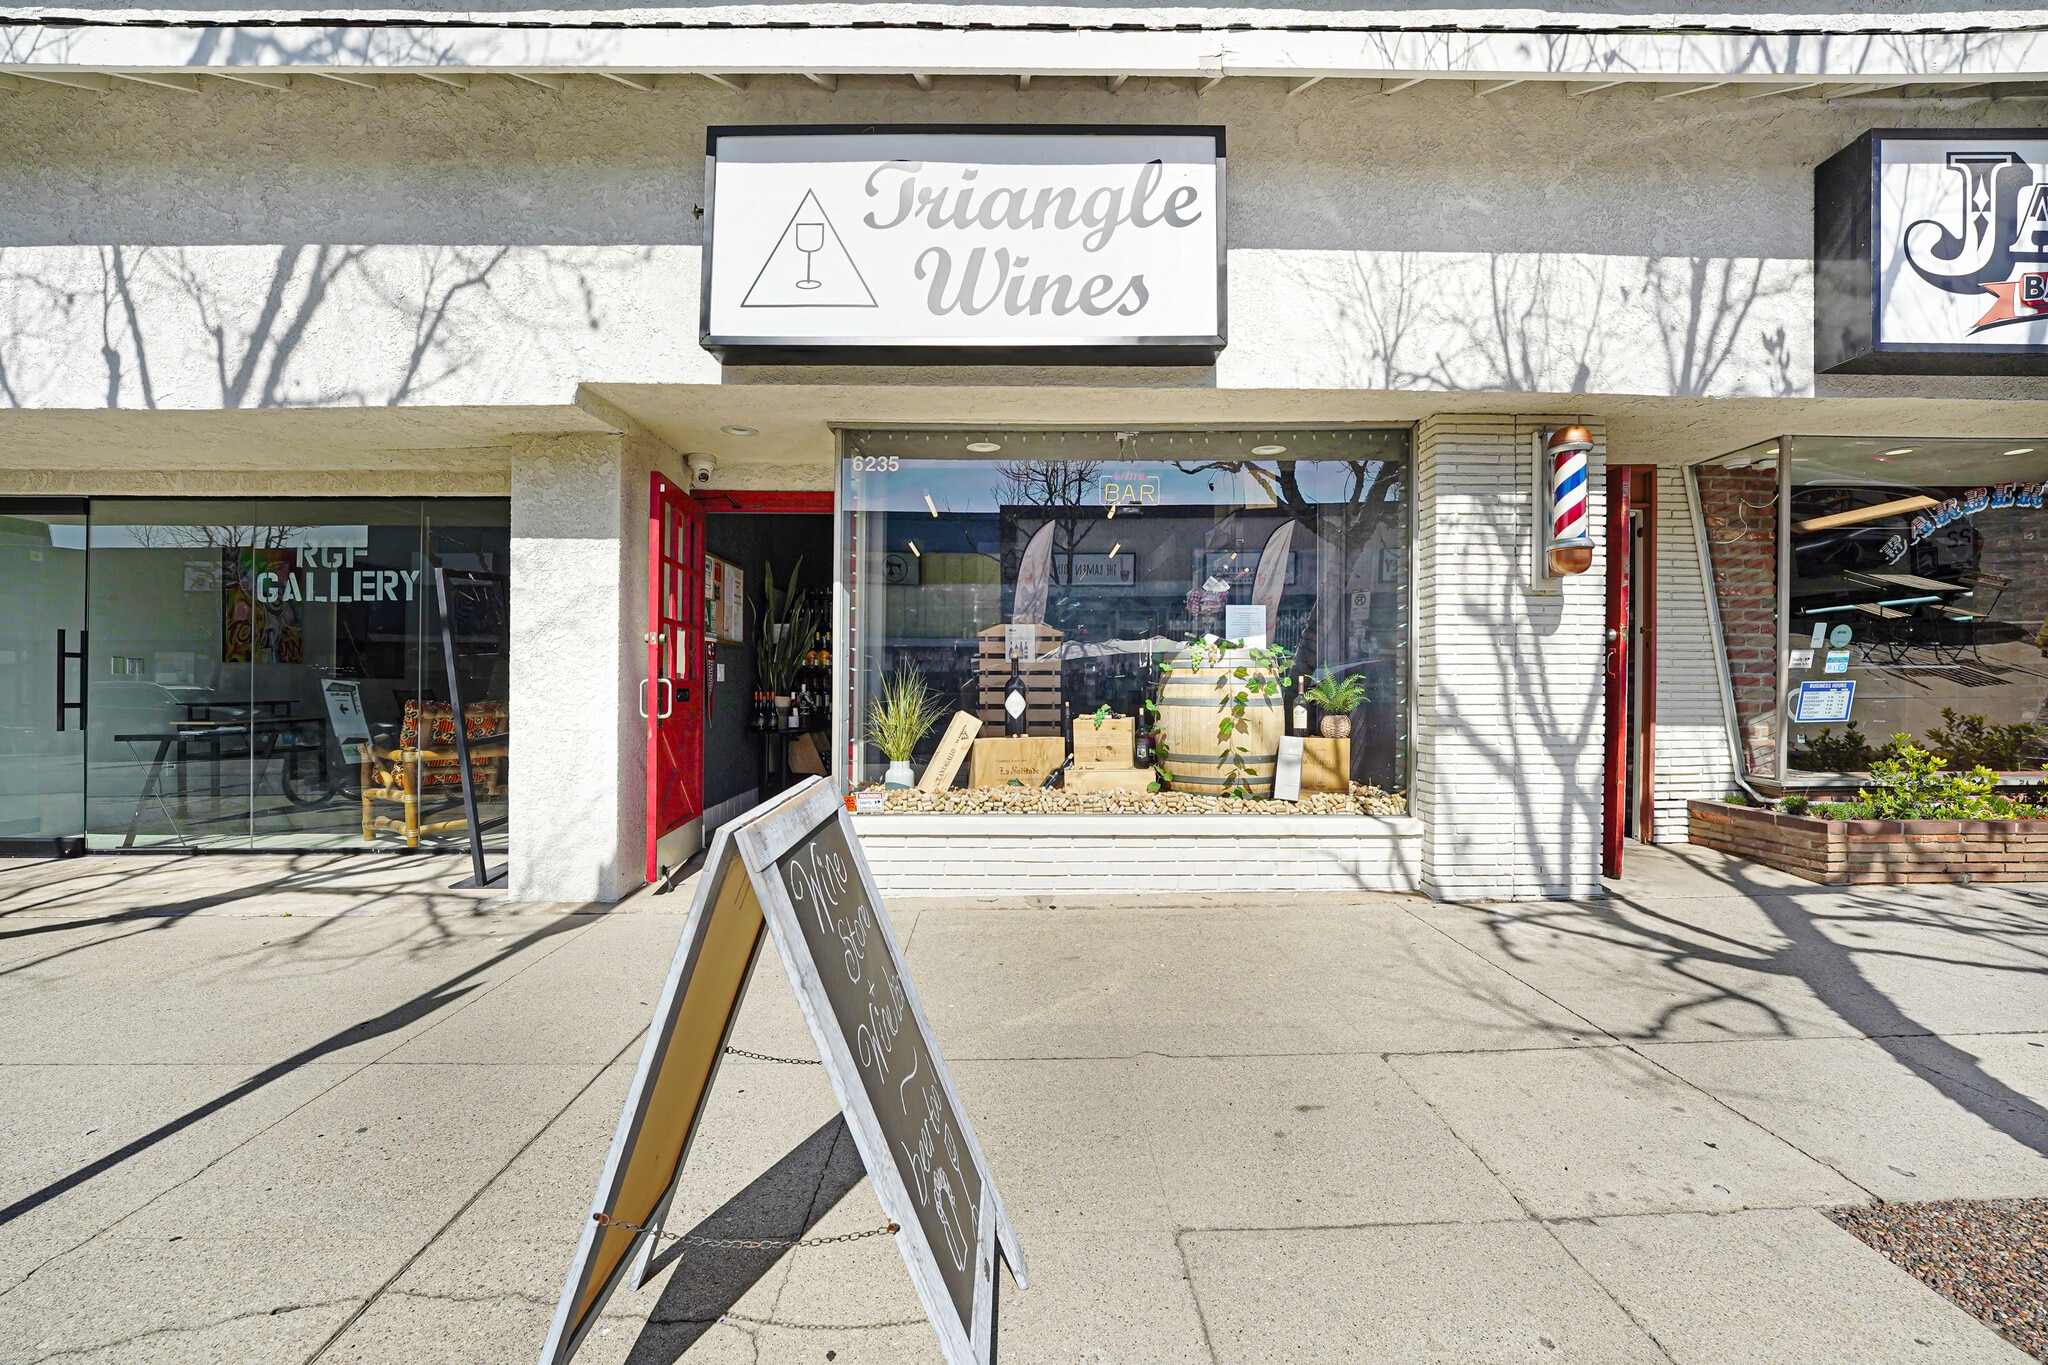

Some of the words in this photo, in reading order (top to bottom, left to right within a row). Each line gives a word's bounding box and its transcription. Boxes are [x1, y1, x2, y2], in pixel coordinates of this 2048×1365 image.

[863, 158, 1202, 253] Triangle
[914, 247, 1149, 317] Wines
[852, 456, 900, 472] 6235
[1105, 483, 1155, 502] BAR
[1114, 471, 1146, 481] wine
[256, 570, 421, 602] GALLERY
[296, 538, 369, 568] RGF
[790, 842, 848, 935] Wine
[837, 904, 871, 985] Store
[857, 1002, 899, 1085] Wine
[901, 1118, 935, 1208] beer
